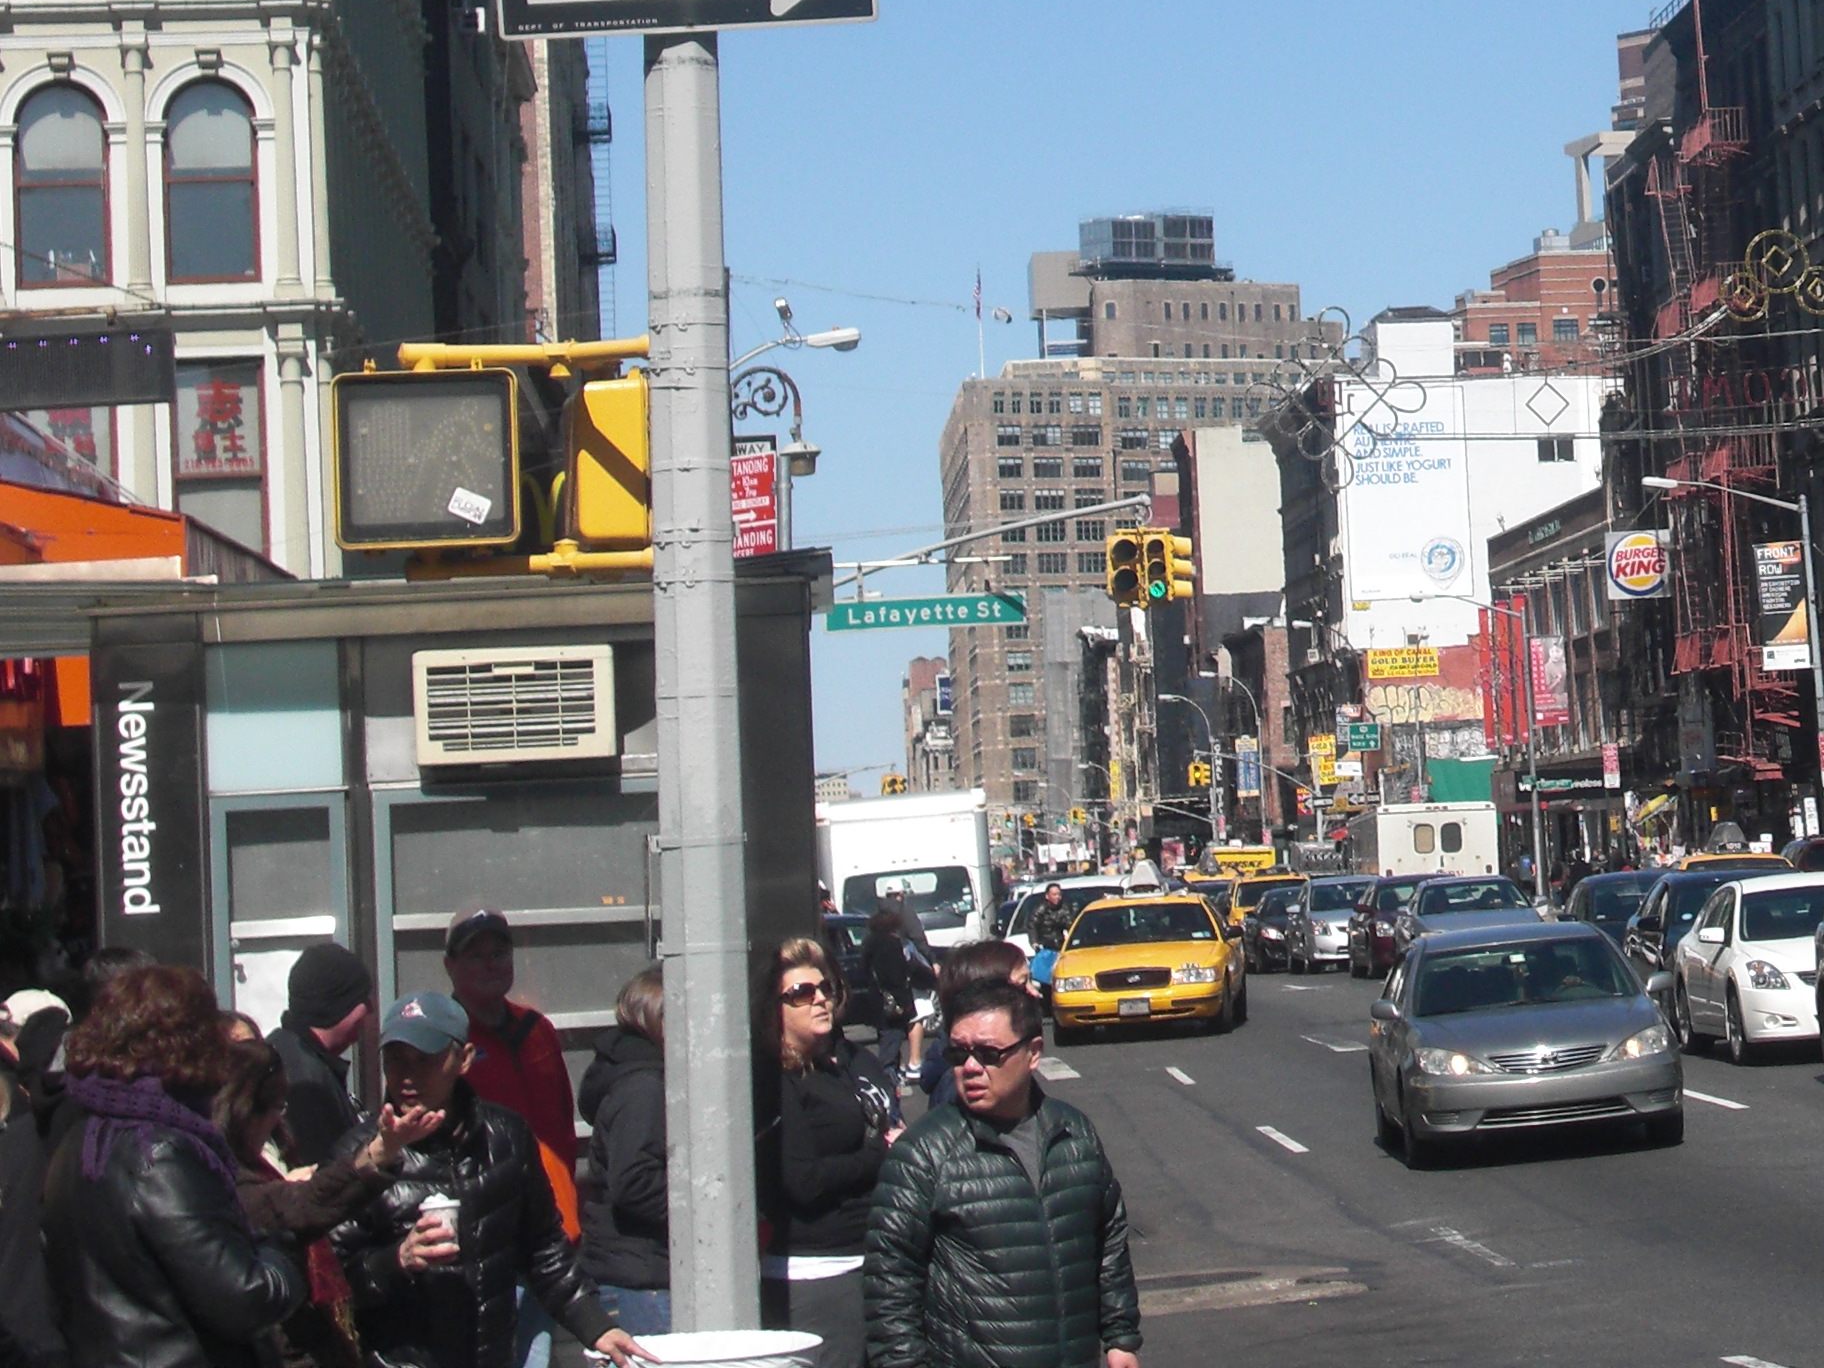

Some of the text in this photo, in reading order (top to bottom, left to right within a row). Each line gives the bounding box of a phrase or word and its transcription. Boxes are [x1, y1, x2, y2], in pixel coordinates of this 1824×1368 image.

[518, 18, 659, 31] DEPT OF TRANSPORTATION
[732, 458, 769, 477] TANDING
[1356, 459, 1452, 474] JUST LIKE YOGURT
[1355, 474, 1401, 486] SHOULD
[1615, 547, 1666, 563] BURGER
[1756, 546, 1795, 560] FRONT
[1615, 559, 1666, 580] KING
[1759, 563, 1783, 576] ROW
[848, 600, 1001, 625] Lafayette St
[117, 681, 161, 915] Newsstand
